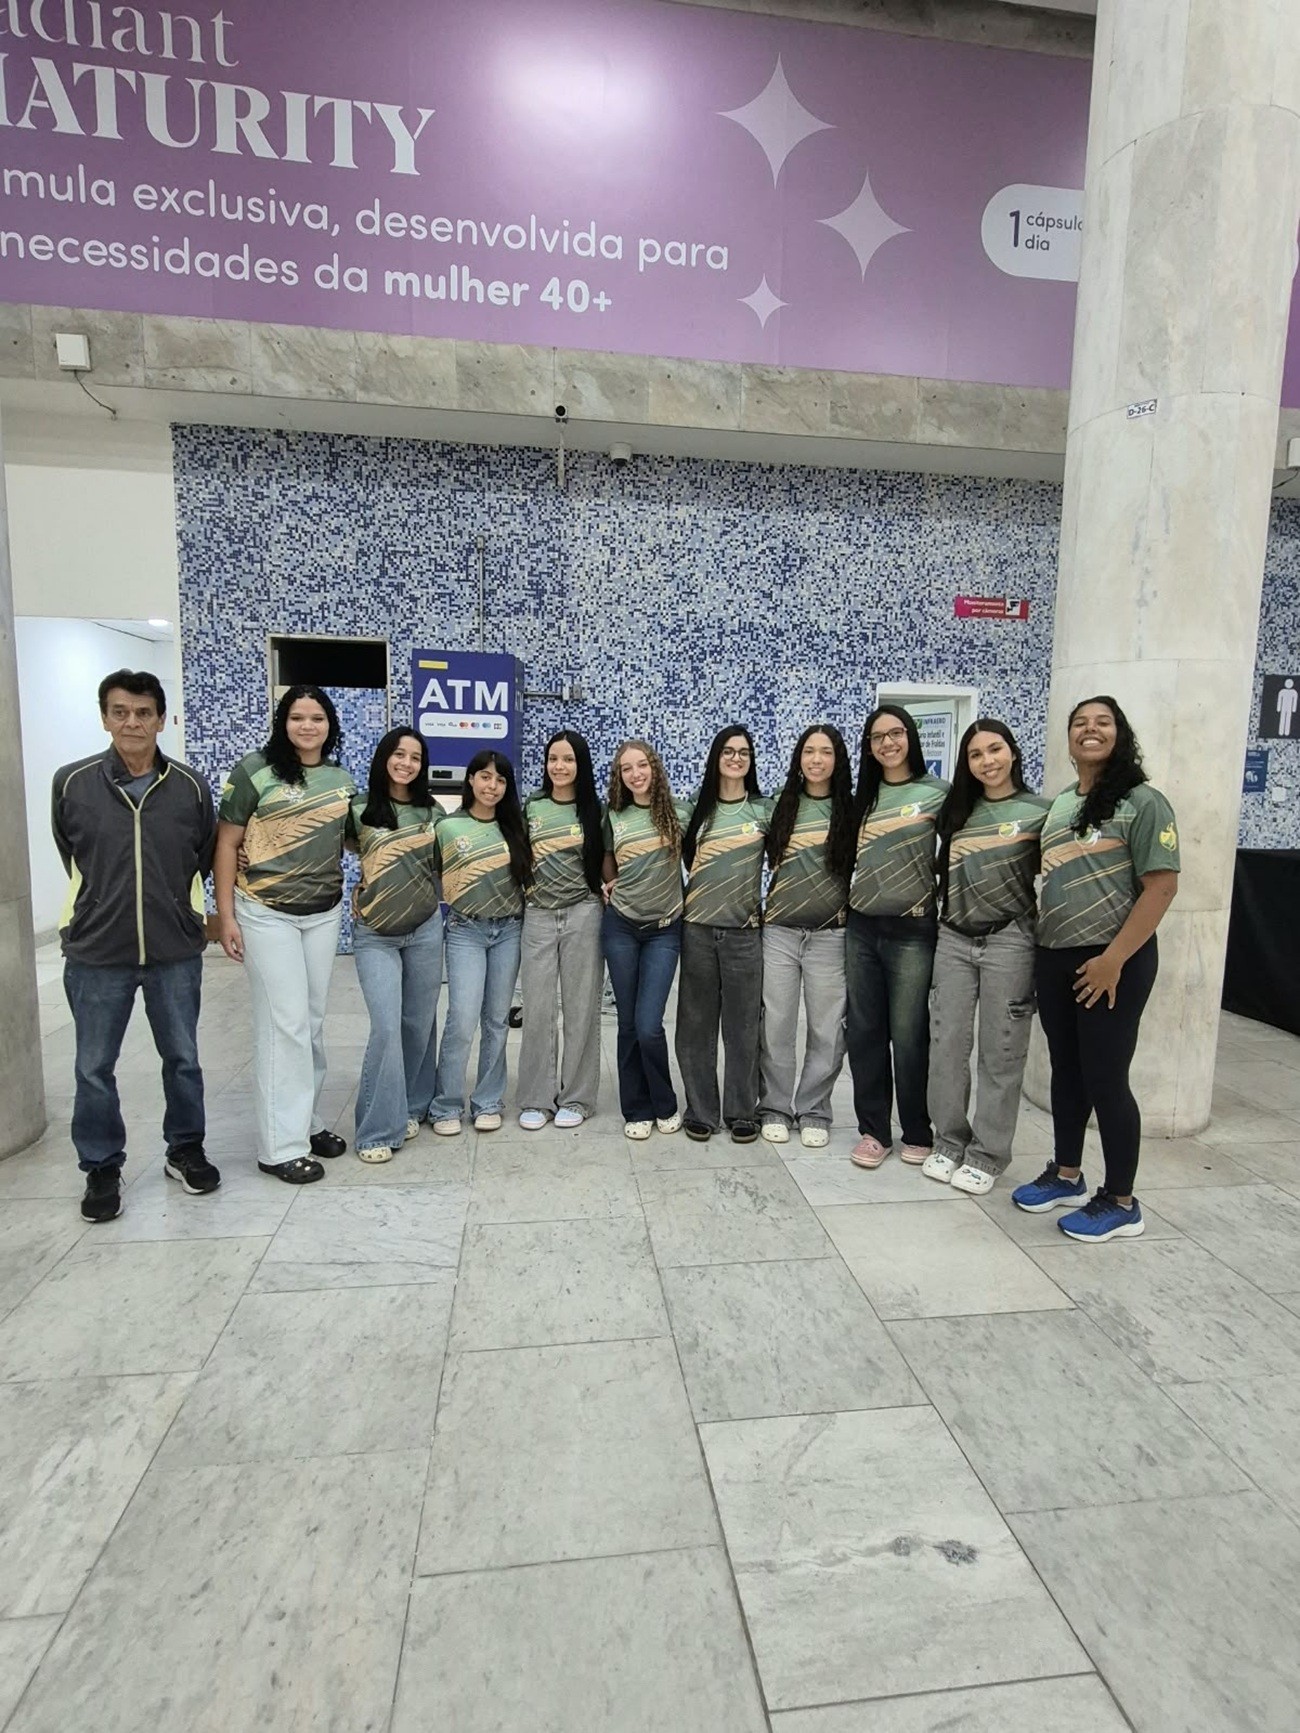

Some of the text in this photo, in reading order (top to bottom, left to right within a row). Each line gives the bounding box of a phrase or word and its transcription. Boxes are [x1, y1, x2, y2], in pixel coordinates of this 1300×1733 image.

[3, 163, 729, 272] mula exclusiva, desenvolvida para
[1009, 209, 1020, 248] 1
[1024, 234, 1051, 251] dia
[0, 231, 612, 313] necessidades da mulher 40+
[418, 678, 509, 712] ATM
